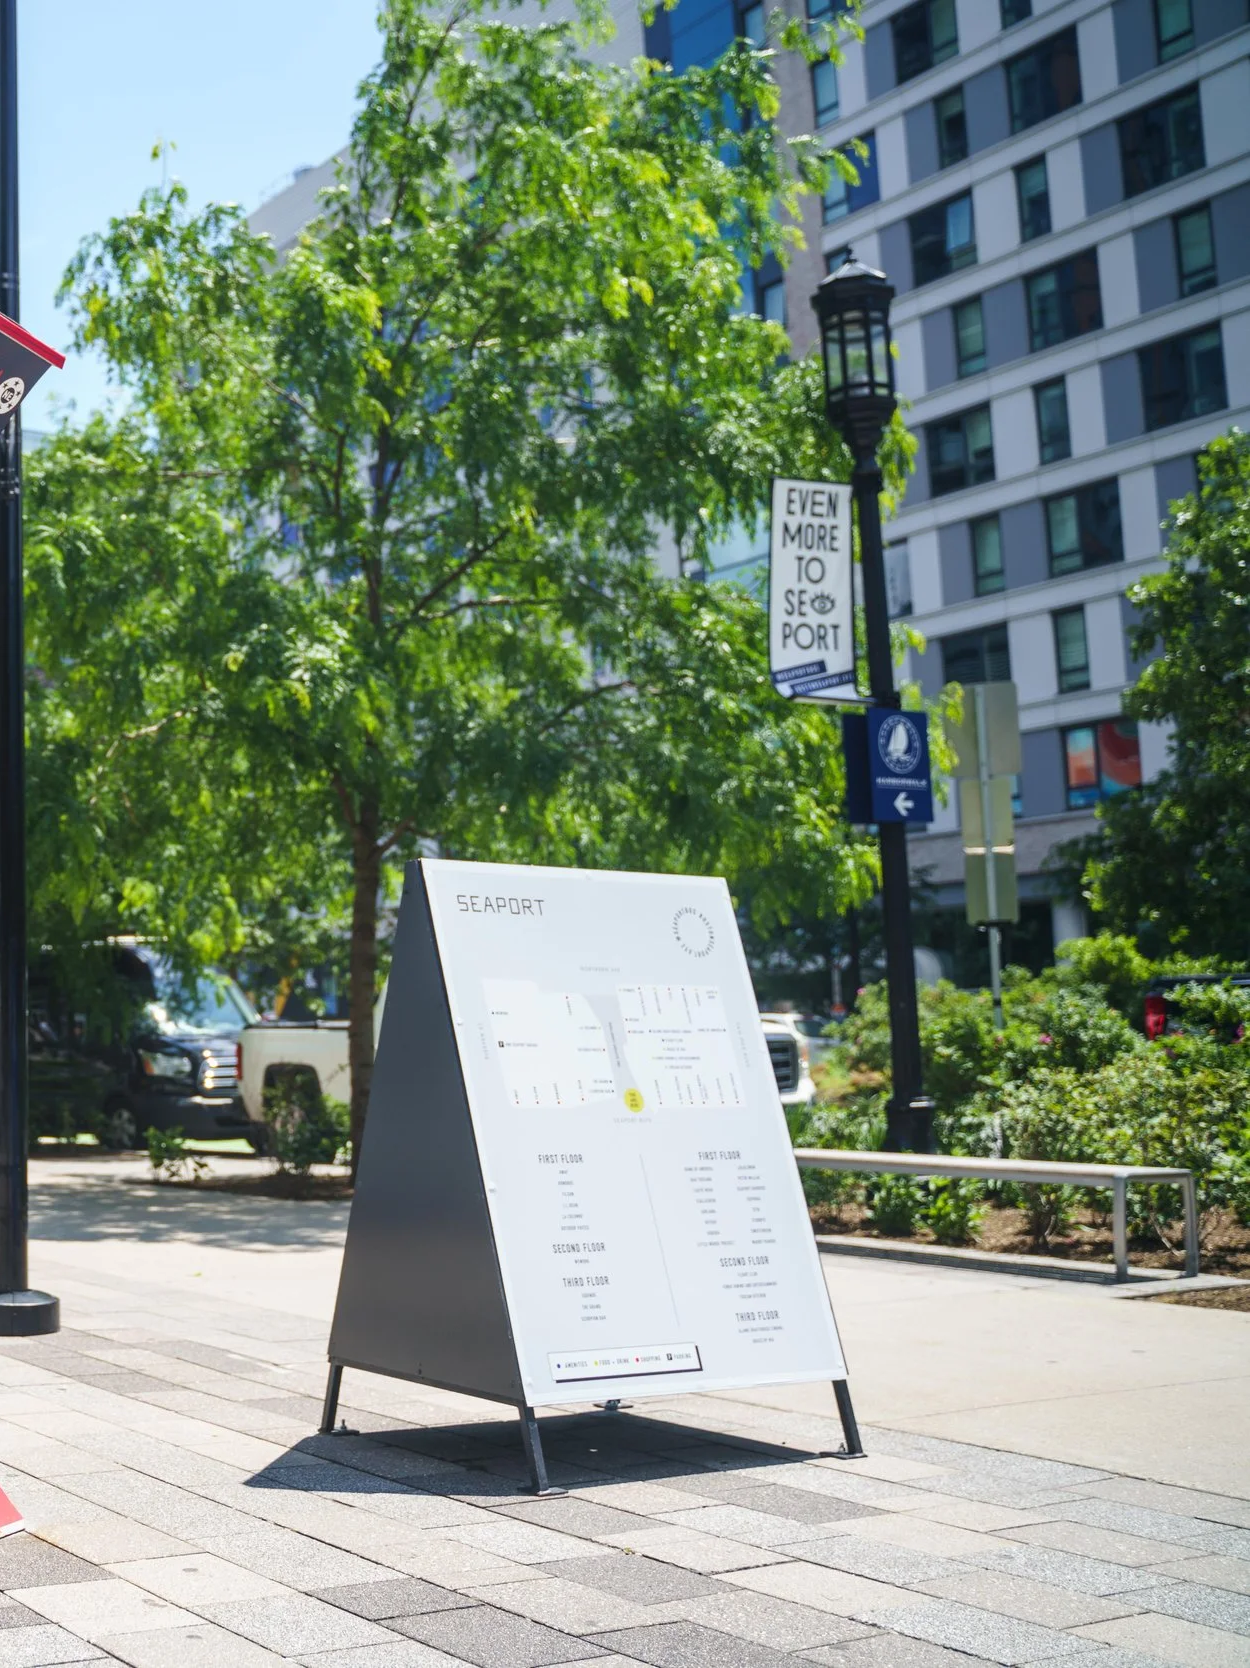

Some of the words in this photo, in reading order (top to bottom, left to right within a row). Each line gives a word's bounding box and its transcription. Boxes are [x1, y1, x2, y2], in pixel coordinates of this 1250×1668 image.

[786, 487, 838, 519] EVEN
[782, 521, 840, 552] MORE
[795, 556, 826, 584] TO
[784, 589, 807, 617] SE
[782, 623, 840, 651] PORT
[456, 895, 545, 916] SEAPORT
[538, 1154, 558, 1164] FIRST
[560, 1153, 584, 1164] FLOOR
[698, 1151, 717, 1160] FIRST
[719, 1150, 741, 1160] FLOOR
[552, 1243, 580, 1254] SECOND
[583, 1242, 606, 1253] FLOOR
[719, 1257, 746, 1267] SECOND
[748, 1256, 770, 1266] FLOOR
[562, 1277, 584, 1287] THIRD
[587, 1276, 610, 1286] FLOOR
[735, 1312, 755, 1322] THIRD
[757, 1310, 780, 1320] FLOOR
